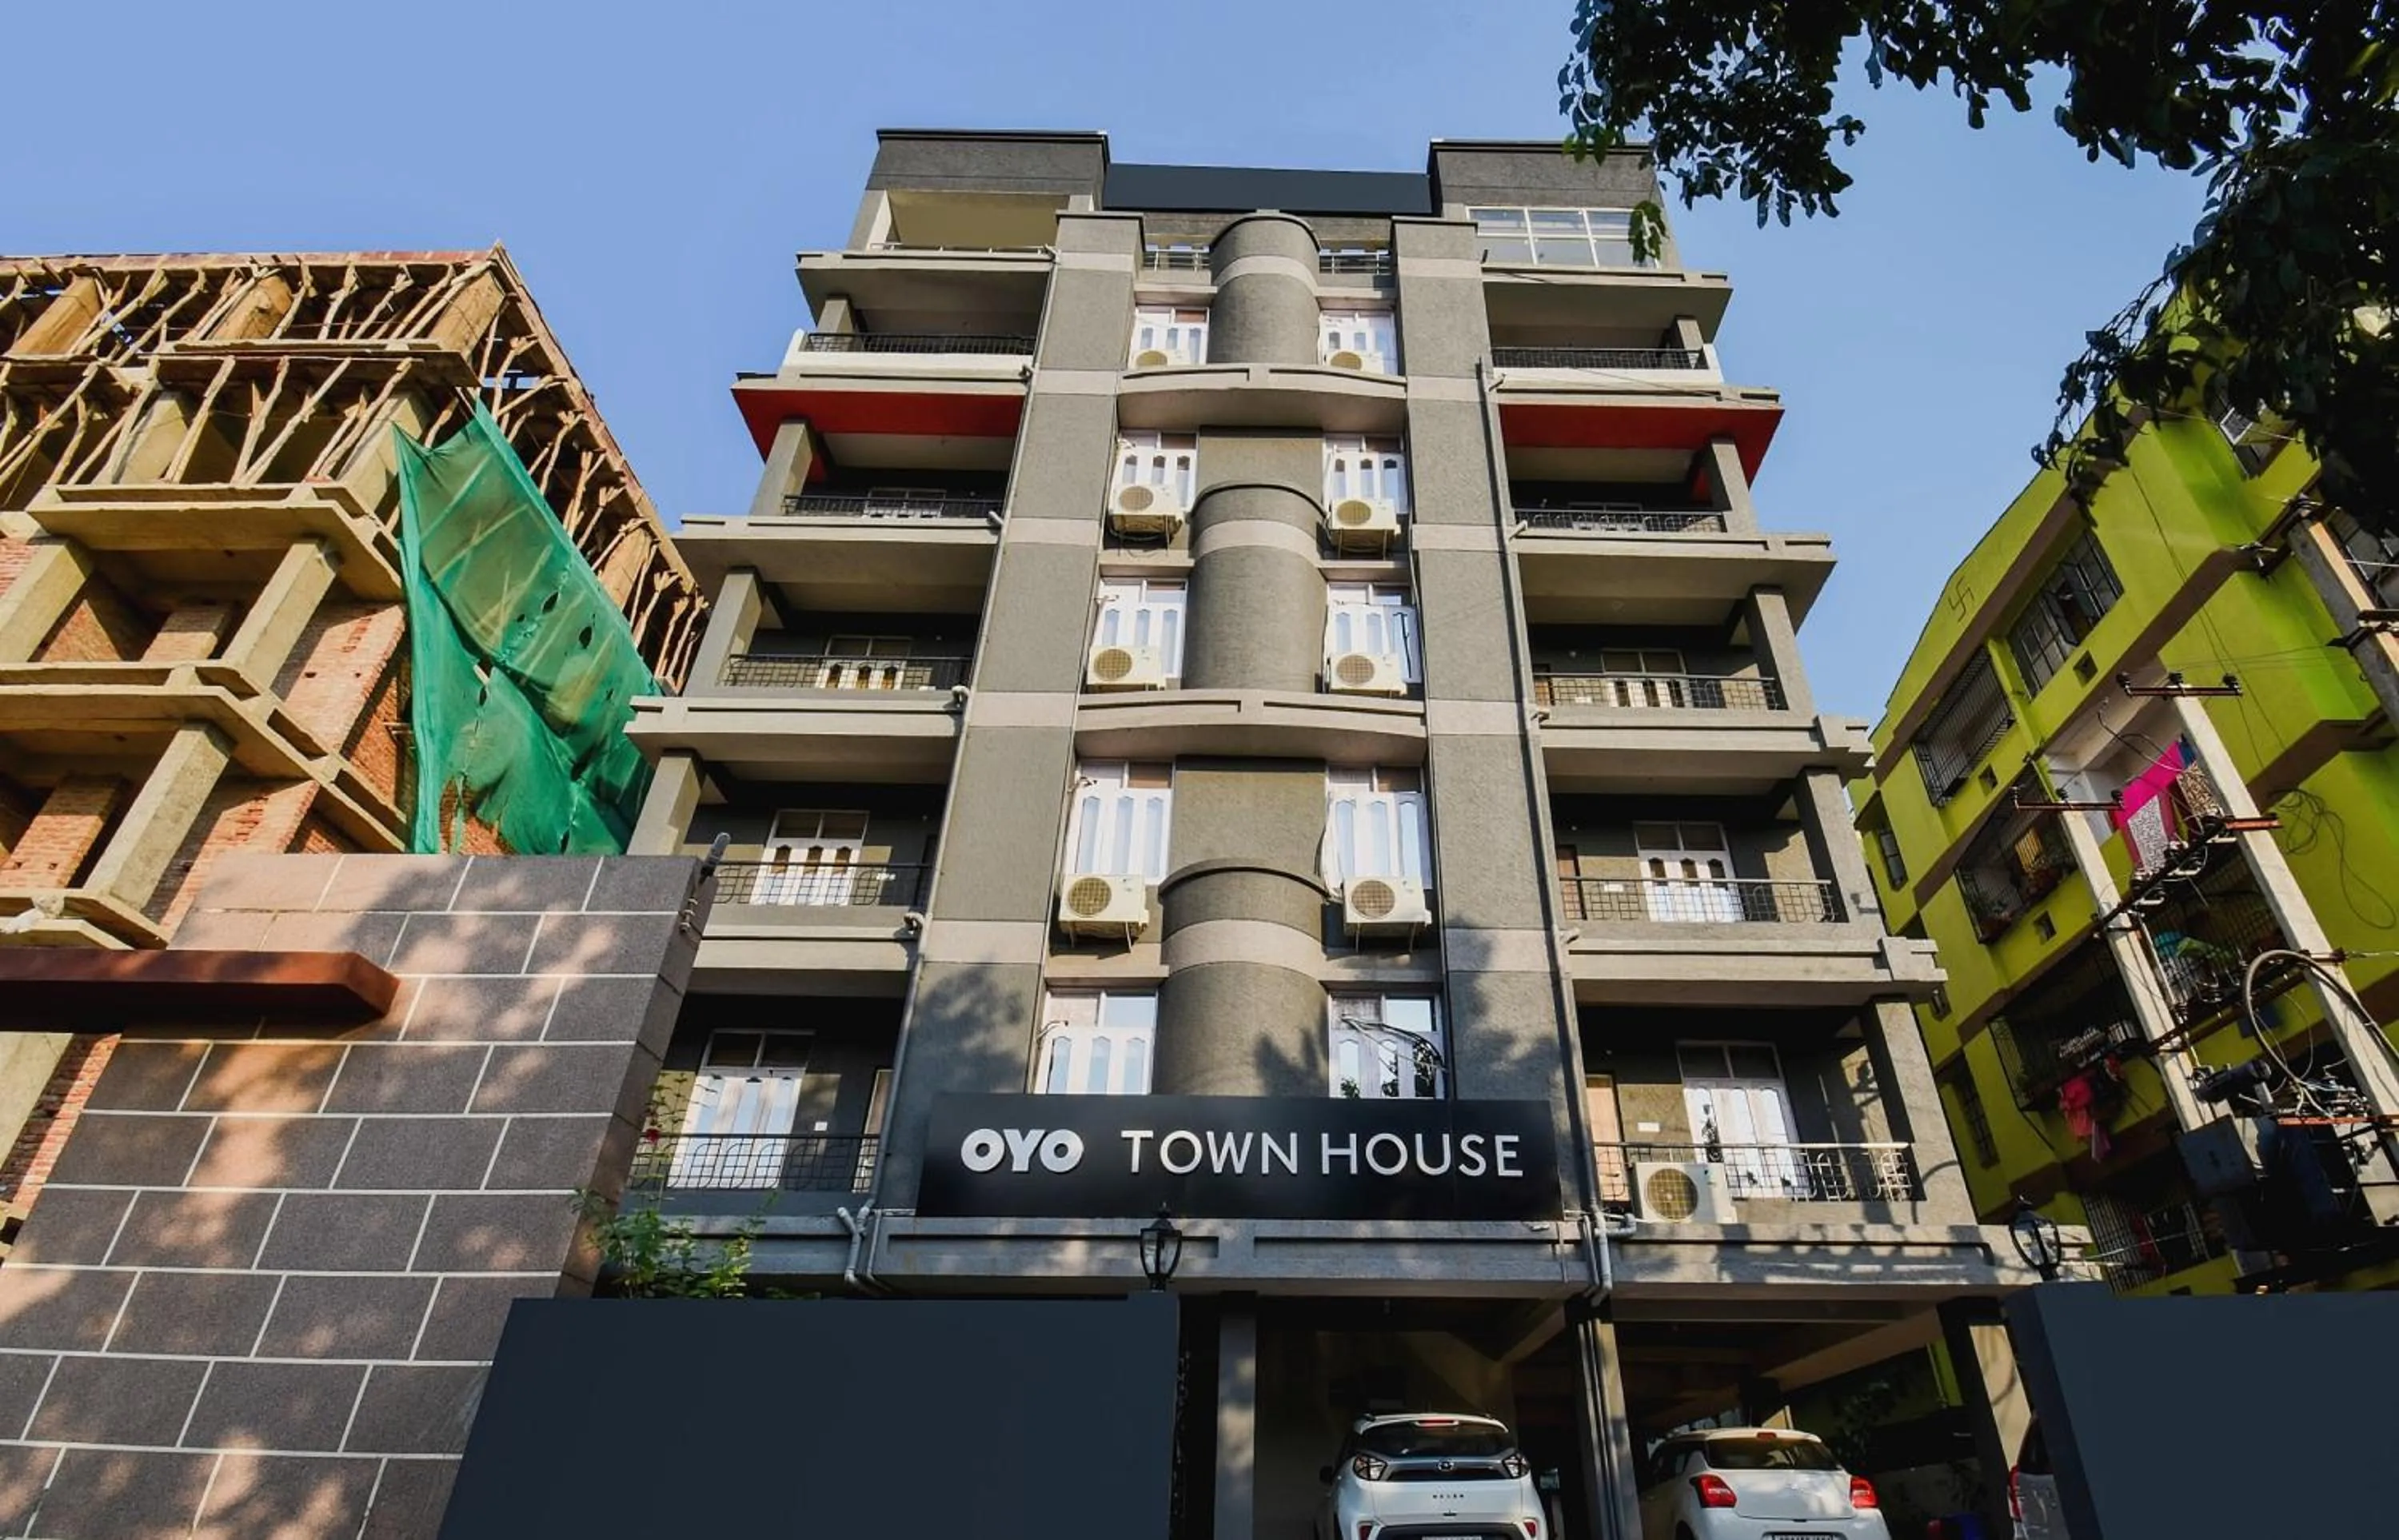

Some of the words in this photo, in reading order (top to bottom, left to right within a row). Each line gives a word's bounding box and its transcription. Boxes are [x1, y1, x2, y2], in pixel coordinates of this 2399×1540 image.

[960, 1128, 1085, 1173] OYO
[1120, 1130, 1298, 1175] TOWN
[1321, 1132, 1523, 1176] HOUSE
